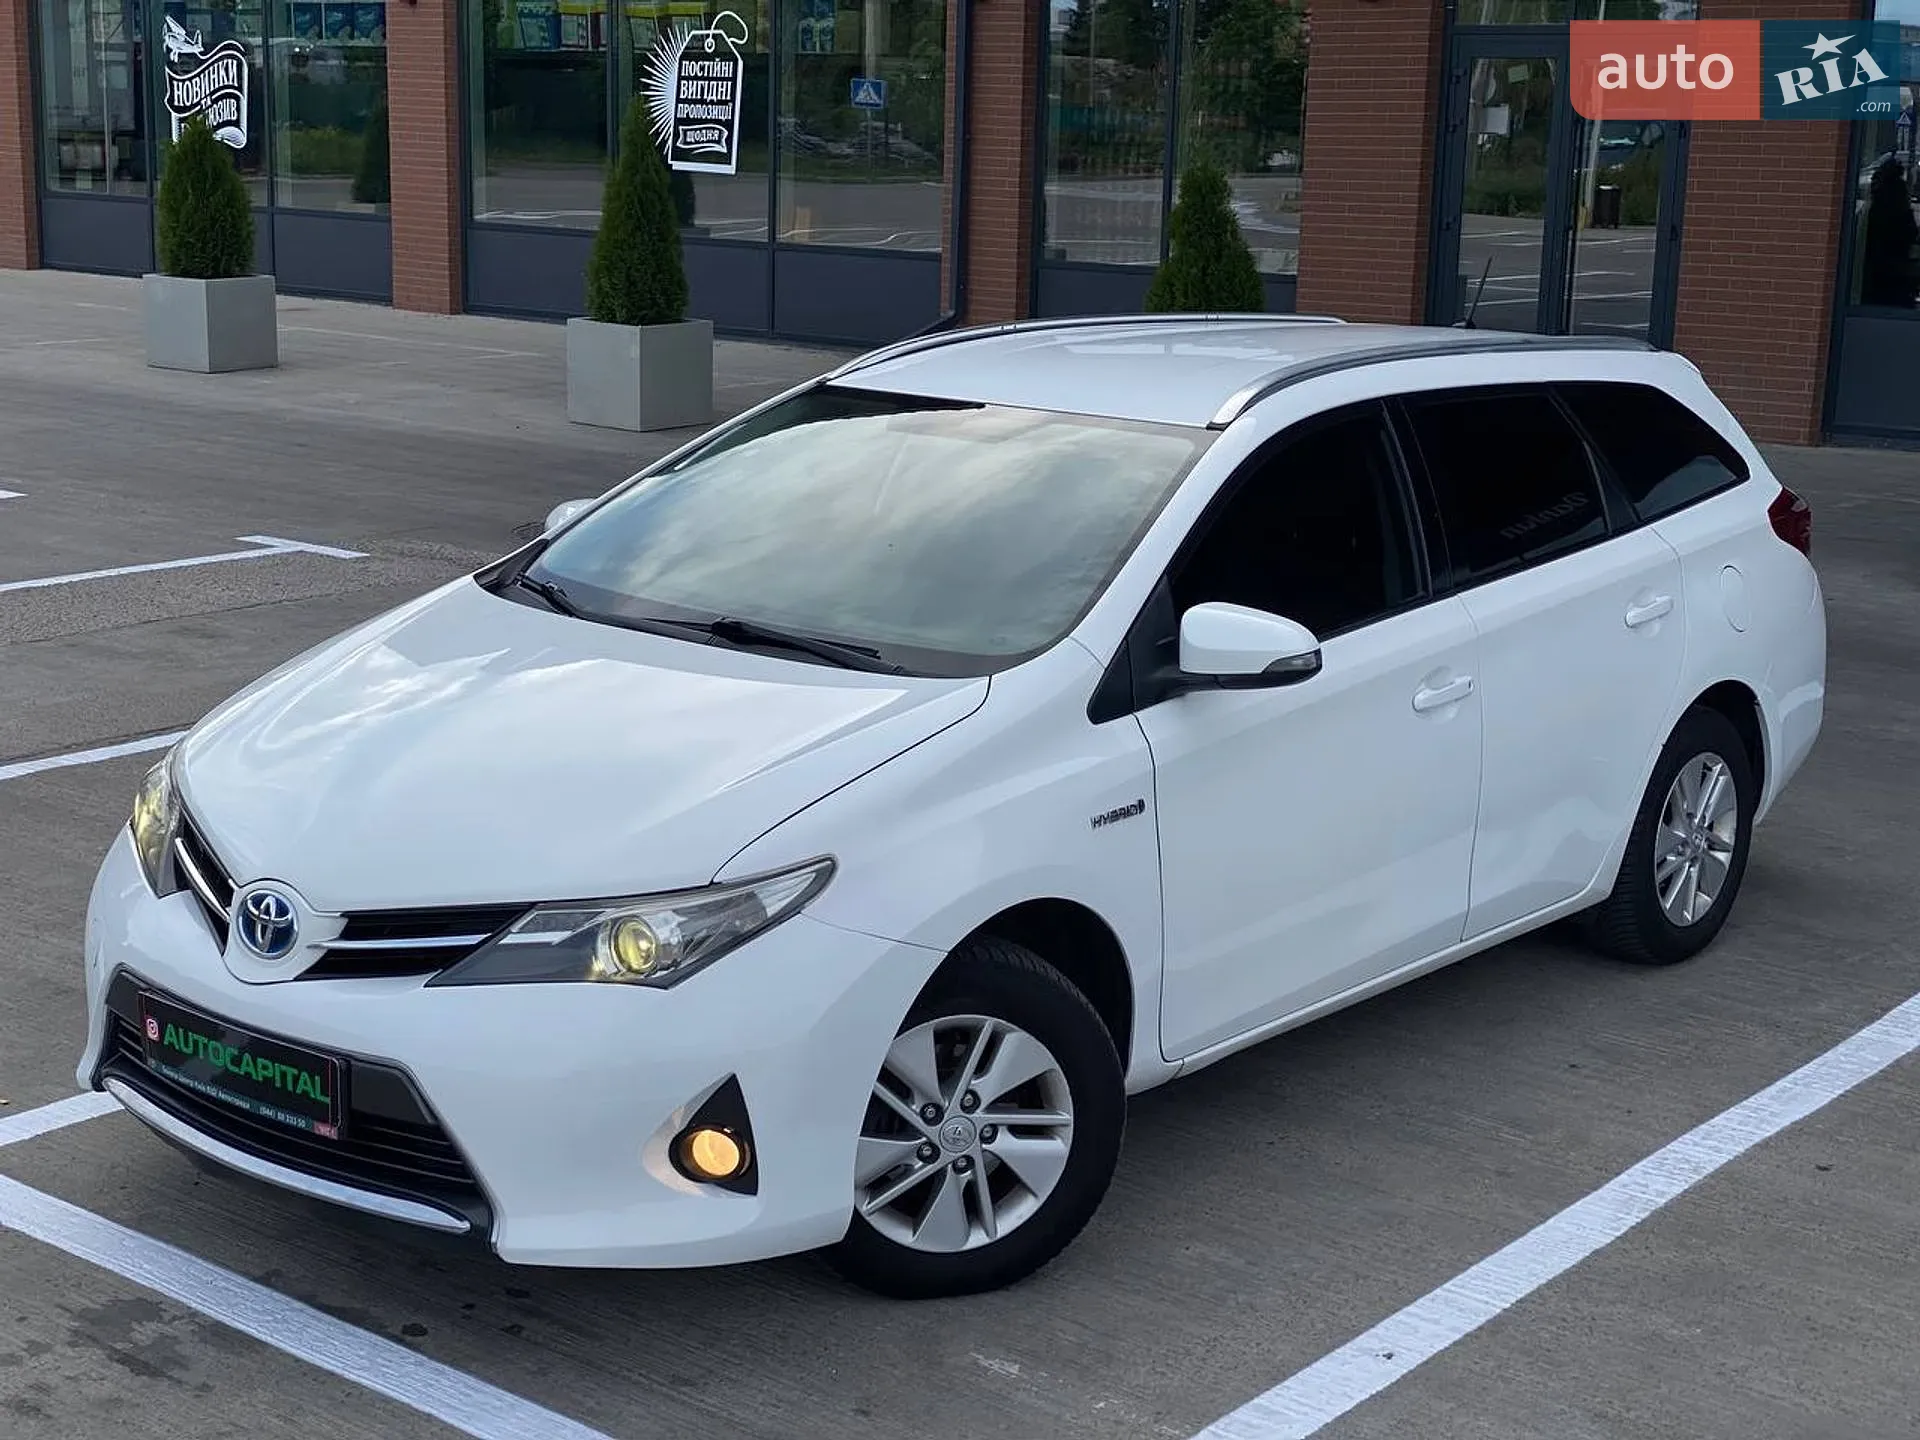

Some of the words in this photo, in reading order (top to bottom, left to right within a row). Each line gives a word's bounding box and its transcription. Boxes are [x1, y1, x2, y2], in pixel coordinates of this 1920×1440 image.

[680, 57, 734, 78] ПОСТІЙНІ
[173, 58, 238, 107] НОВИНКИ
[679, 80, 732, 102] ВИГІДНІ
[676, 102, 733, 121] ПРОПОЗИЦІЇ
[1090, 804, 1138, 829] HYBRID
[163, 1023, 331, 1104] AUTOCAPITAL
